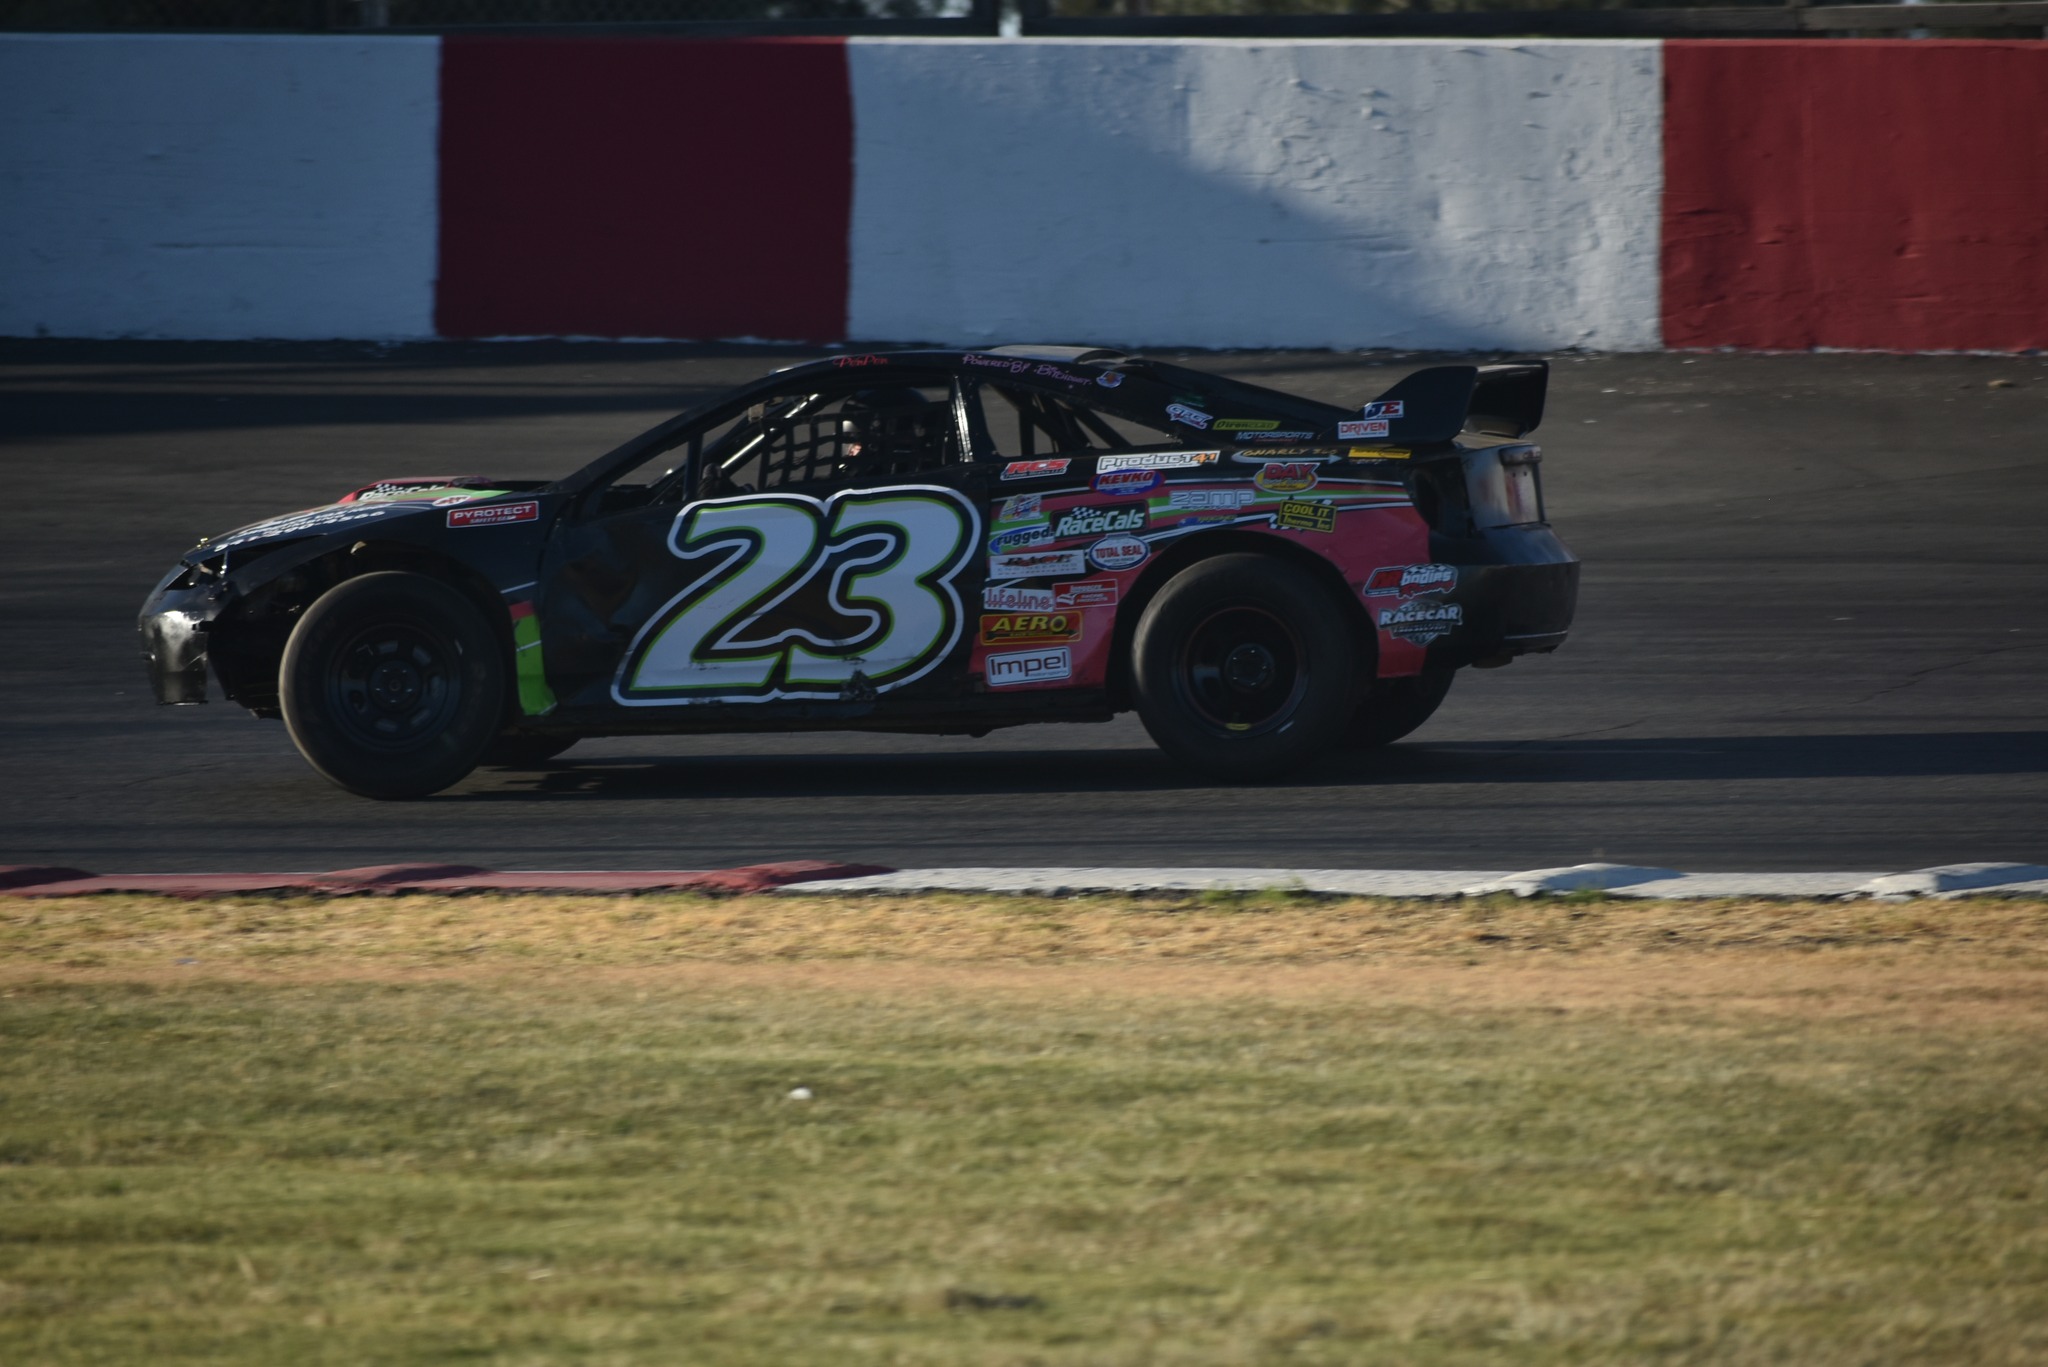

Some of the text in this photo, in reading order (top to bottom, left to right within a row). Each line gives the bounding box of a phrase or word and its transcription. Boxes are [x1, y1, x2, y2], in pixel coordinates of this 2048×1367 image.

[1366, 402, 1401, 418] JE
[1235, 432, 1314, 441] MOTORSPORTS
[1341, 422, 1387, 435] DRIVEN
[1098, 471, 1155, 486] KEVKO
[1265, 463, 1316, 480] DAY
[454, 506, 532, 519] PYROTECT
[1284, 503, 1330, 518] COOL IT
[1055, 509, 1145, 537] RaceCals
[1094, 545, 1143, 559] TOTAL SEAL
[1400, 570, 1452, 586] bodies
[611, 484, 981, 707] 23
[991, 615, 1067, 632] AERO
[1379, 606, 1459, 625] RACECAR
